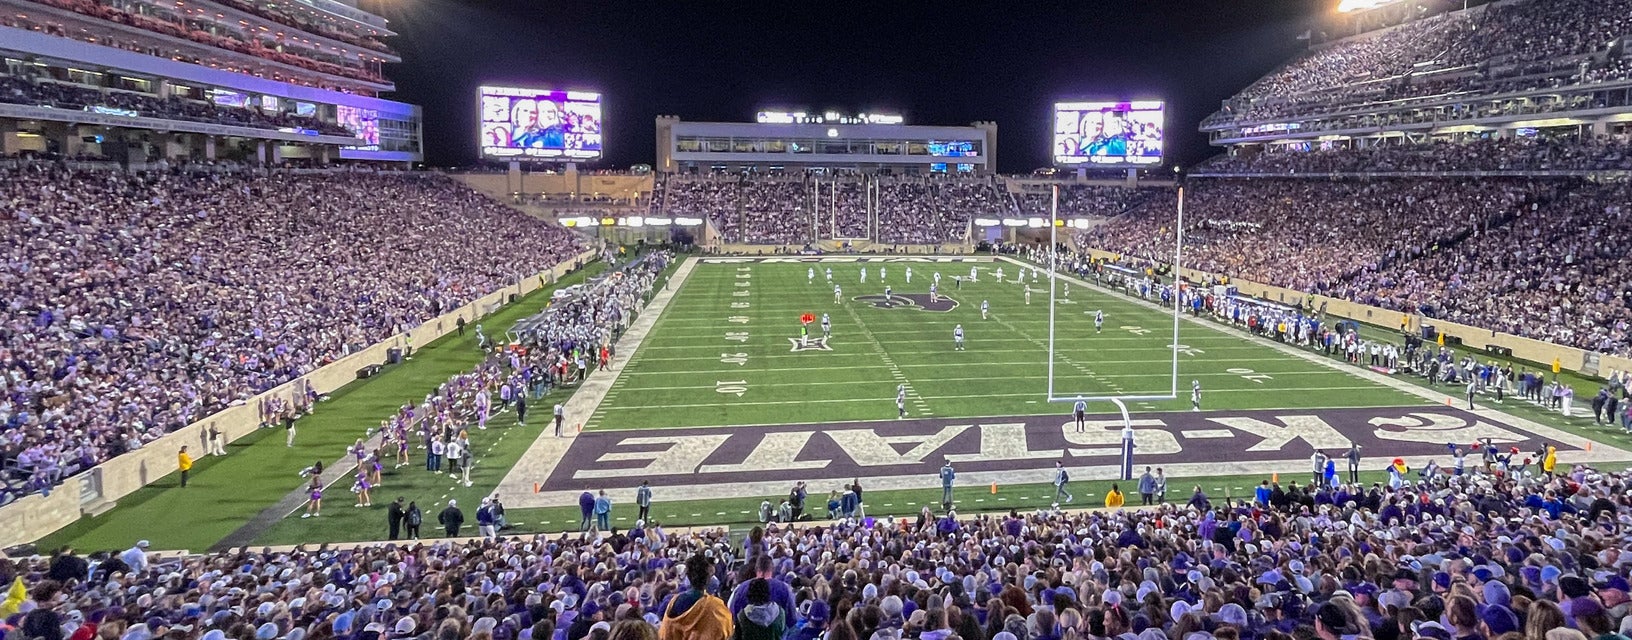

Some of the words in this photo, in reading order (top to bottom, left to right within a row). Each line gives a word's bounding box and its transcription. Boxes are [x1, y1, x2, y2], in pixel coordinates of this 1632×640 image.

[1226, 368, 1274, 380] 10
[716, 380, 747, 393] 10
[572, 414, 1363, 480] K-STATE
